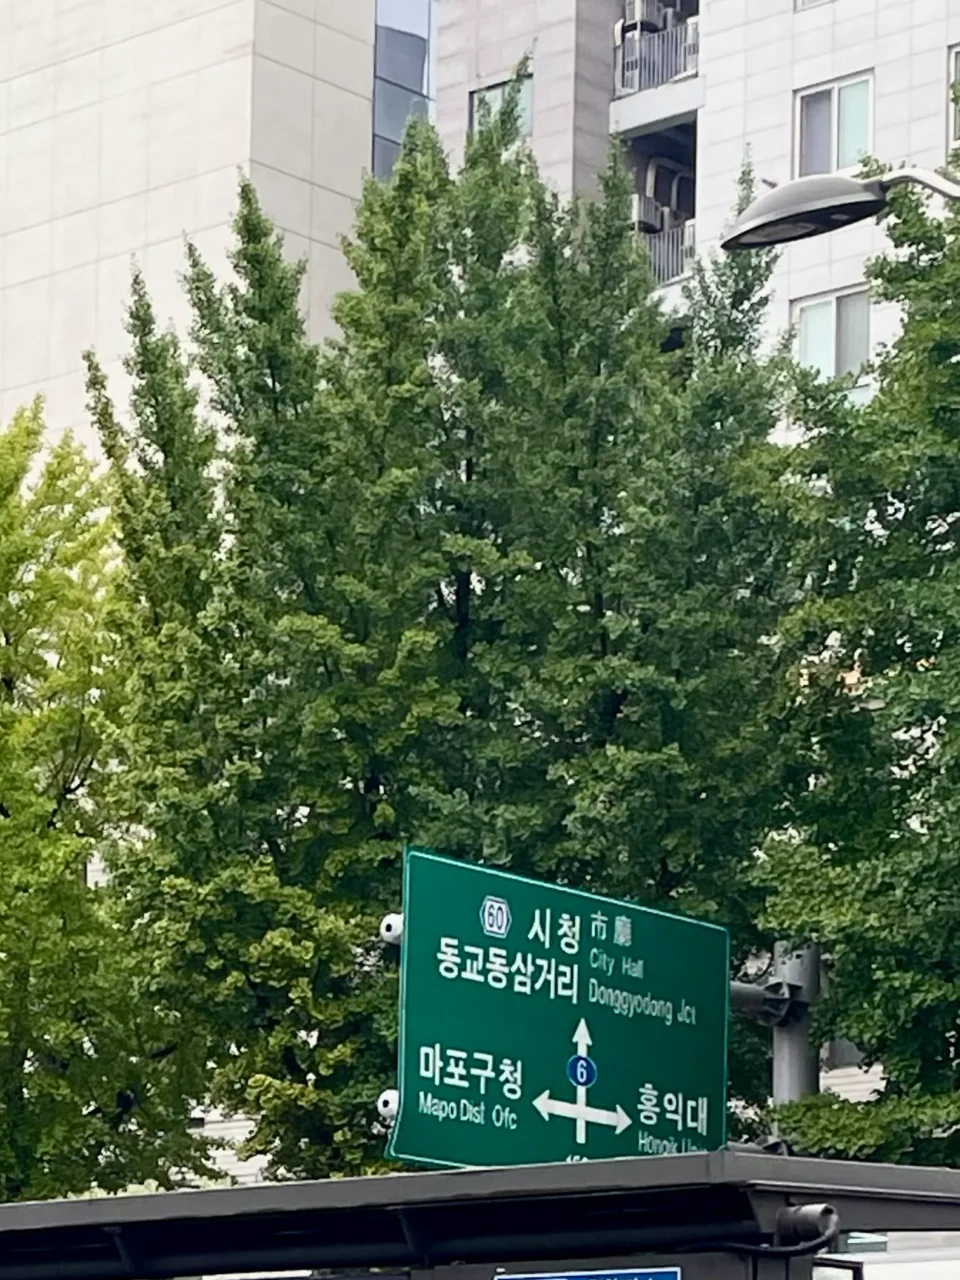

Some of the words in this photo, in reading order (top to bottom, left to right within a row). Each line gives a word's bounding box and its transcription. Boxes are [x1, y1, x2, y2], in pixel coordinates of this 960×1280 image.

[485, 902, 505, 925] 60
[527, 908, 581, 954] 시청
[437, 937, 579, 1004] 동교동삼거리
[589, 948, 615, 975] City
[621, 953, 644, 979] Hall
[589, 979, 673, 1026] Donggyodong
[419, 1043, 523, 1100] 마포구청
[576, 1060, 588, 1082] 6
[419, 1092, 457, 1122] Mapo
[460, 1099, 485, 1125] Dist
[492, 1104, 518, 1130] Ofc
[637, 1082, 708, 1136] 홍익대
